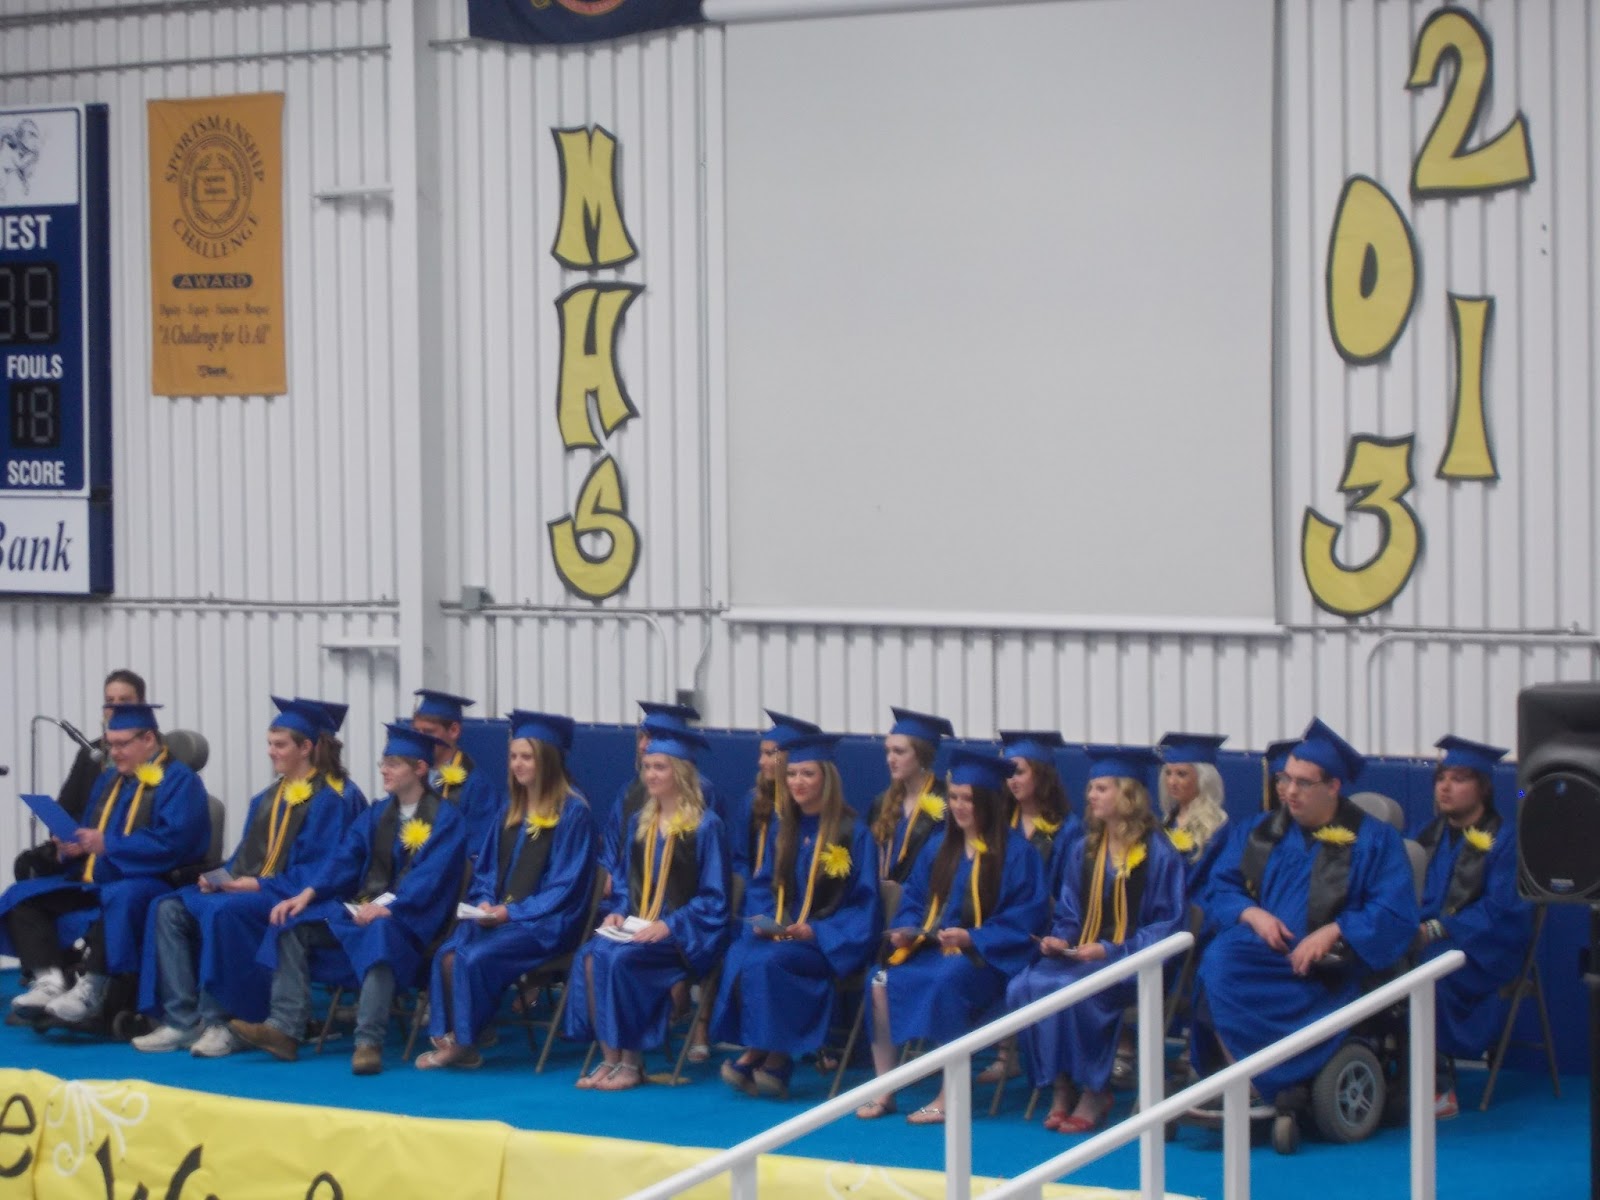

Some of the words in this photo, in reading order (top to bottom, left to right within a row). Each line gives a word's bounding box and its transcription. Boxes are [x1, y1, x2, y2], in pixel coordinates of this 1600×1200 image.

[164, 114, 266, 184] SPORTSMANSHIP
[172, 212, 260, 259] CHALLENGE
[179, 274, 250, 289] AWARD
[6, 353, 63, 380] FOULS
[7, 459, 65, 487] SCORE
